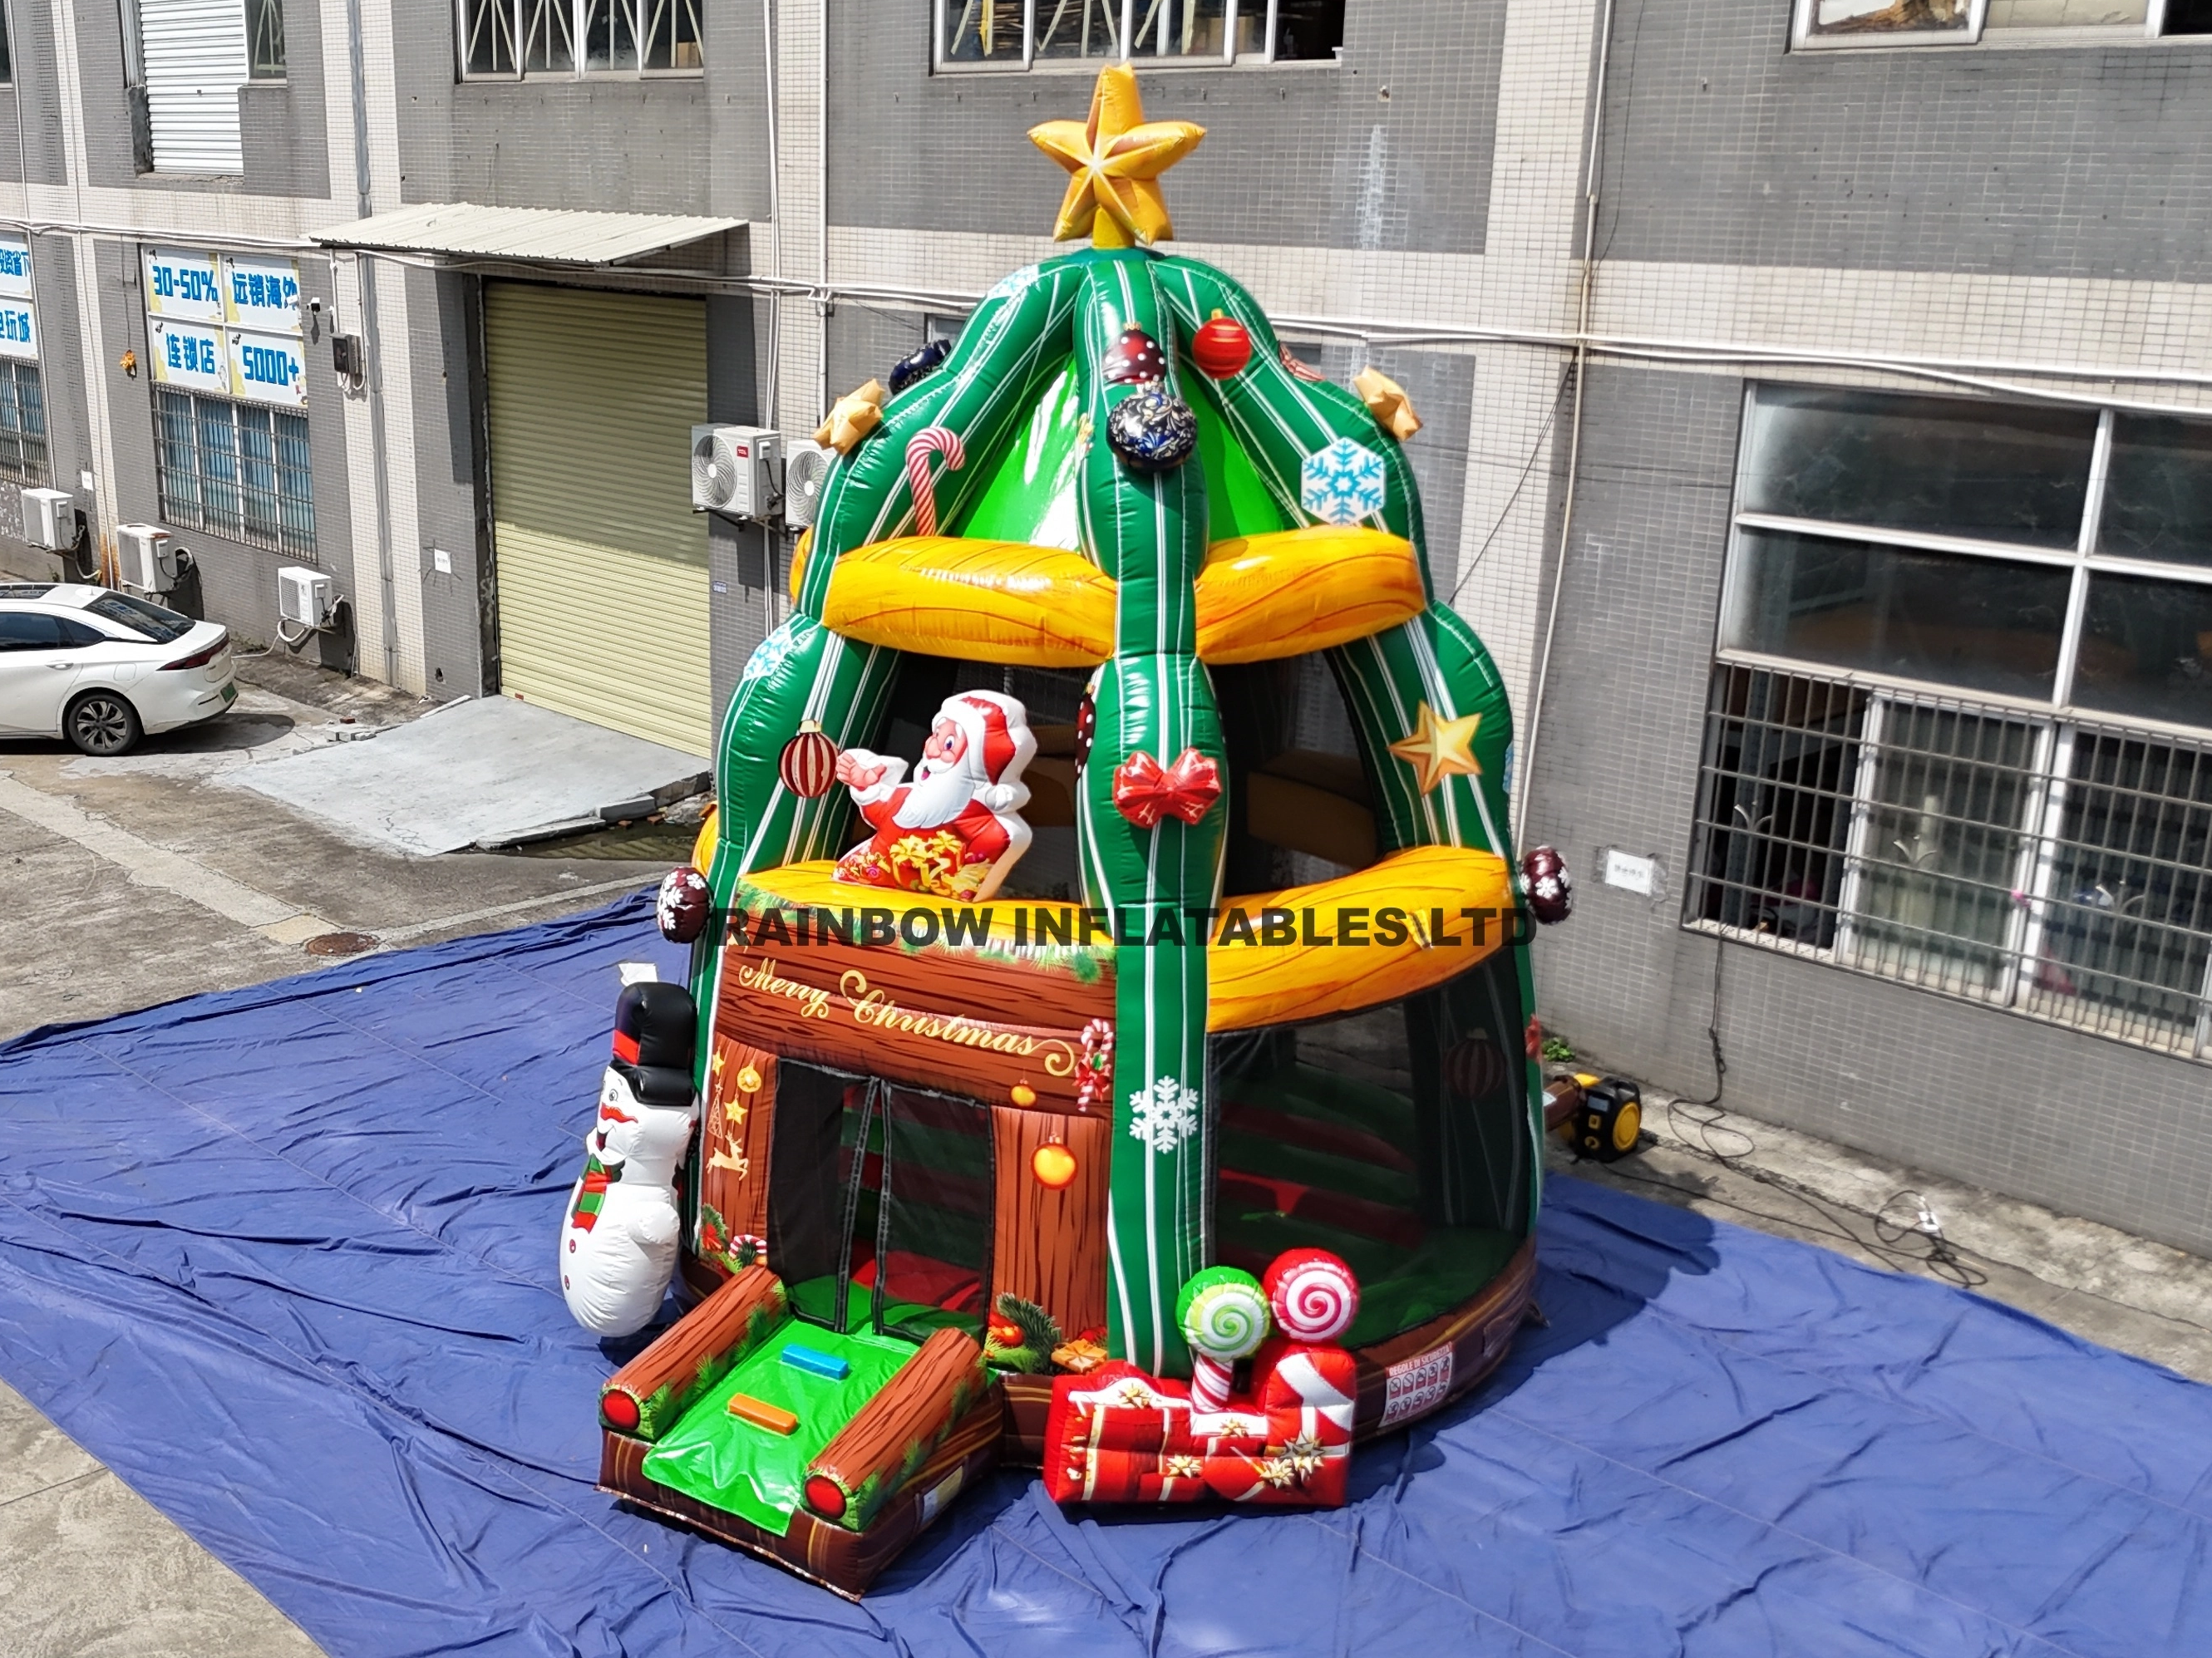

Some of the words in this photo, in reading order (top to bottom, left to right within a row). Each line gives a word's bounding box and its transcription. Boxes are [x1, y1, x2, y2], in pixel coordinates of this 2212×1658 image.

[152, 265, 218, 302] 30-50%
[232, 271, 298, 311] 远销海外
[166, 332, 215, 374] 连锁店
[243, 345, 298, 386] 5000+
[738, 957, 829, 1019] Merry
[839, 969, 1076, 1077] Christmas
[1388, 1361, 1414, 1377] REGOLE
[1414, 1359, 1421, 1368] DI
